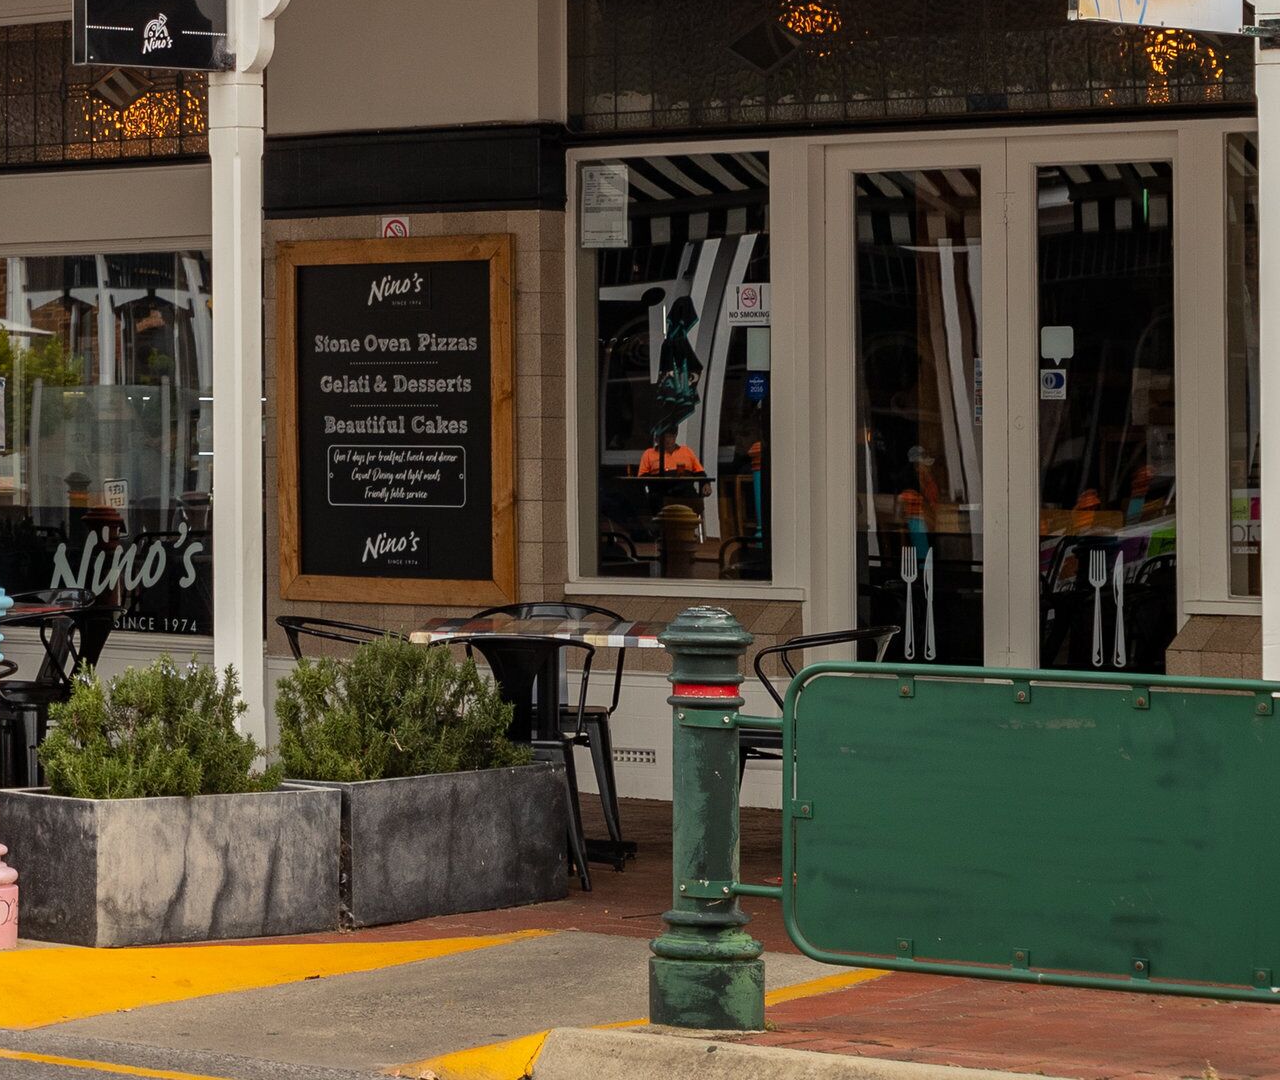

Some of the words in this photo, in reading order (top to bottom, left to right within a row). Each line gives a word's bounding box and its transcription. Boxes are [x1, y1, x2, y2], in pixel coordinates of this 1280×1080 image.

[142, 37, 173, 54] Nino's
[367, 272, 424, 306] Nino's
[740, 311, 770, 319] SMOKING
[314, 334, 360, 353] Stone
[364, 334, 411, 352] Oven
[417, 333, 478, 351] Pizzas
[320, 375, 370, 393] Gelati
[373, 375, 387, 393] &
[393, 375, 472, 393] Desserts
[324, 415, 406, 434] Beautiful
[411, 415, 468, 434] Cakes
[352, 451, 365, 465] days
[366, 452, 376, 465] for
[407, 450, 424, 462] lunch
[426, 451, 437, 462] and
[438, 451, 458, 462] dinner
[351, 467, 371, 481] Casual
[372, 467, 394, 485] Dining
[395, 469, 406, 480] and
[407, 469, 423, 485] light
[423, 469, 441, 482] meals
[364, 485, 389, 502] Friendly
[390, 487, 405, 500] table
[406, 490, 428, 500] service
[362, 530, 420, 563] Nino's
[50, 521, 204, 597] Nino's
[113, 617, 154, 630] SINCE
[164, 619, 197, 632] 1974
